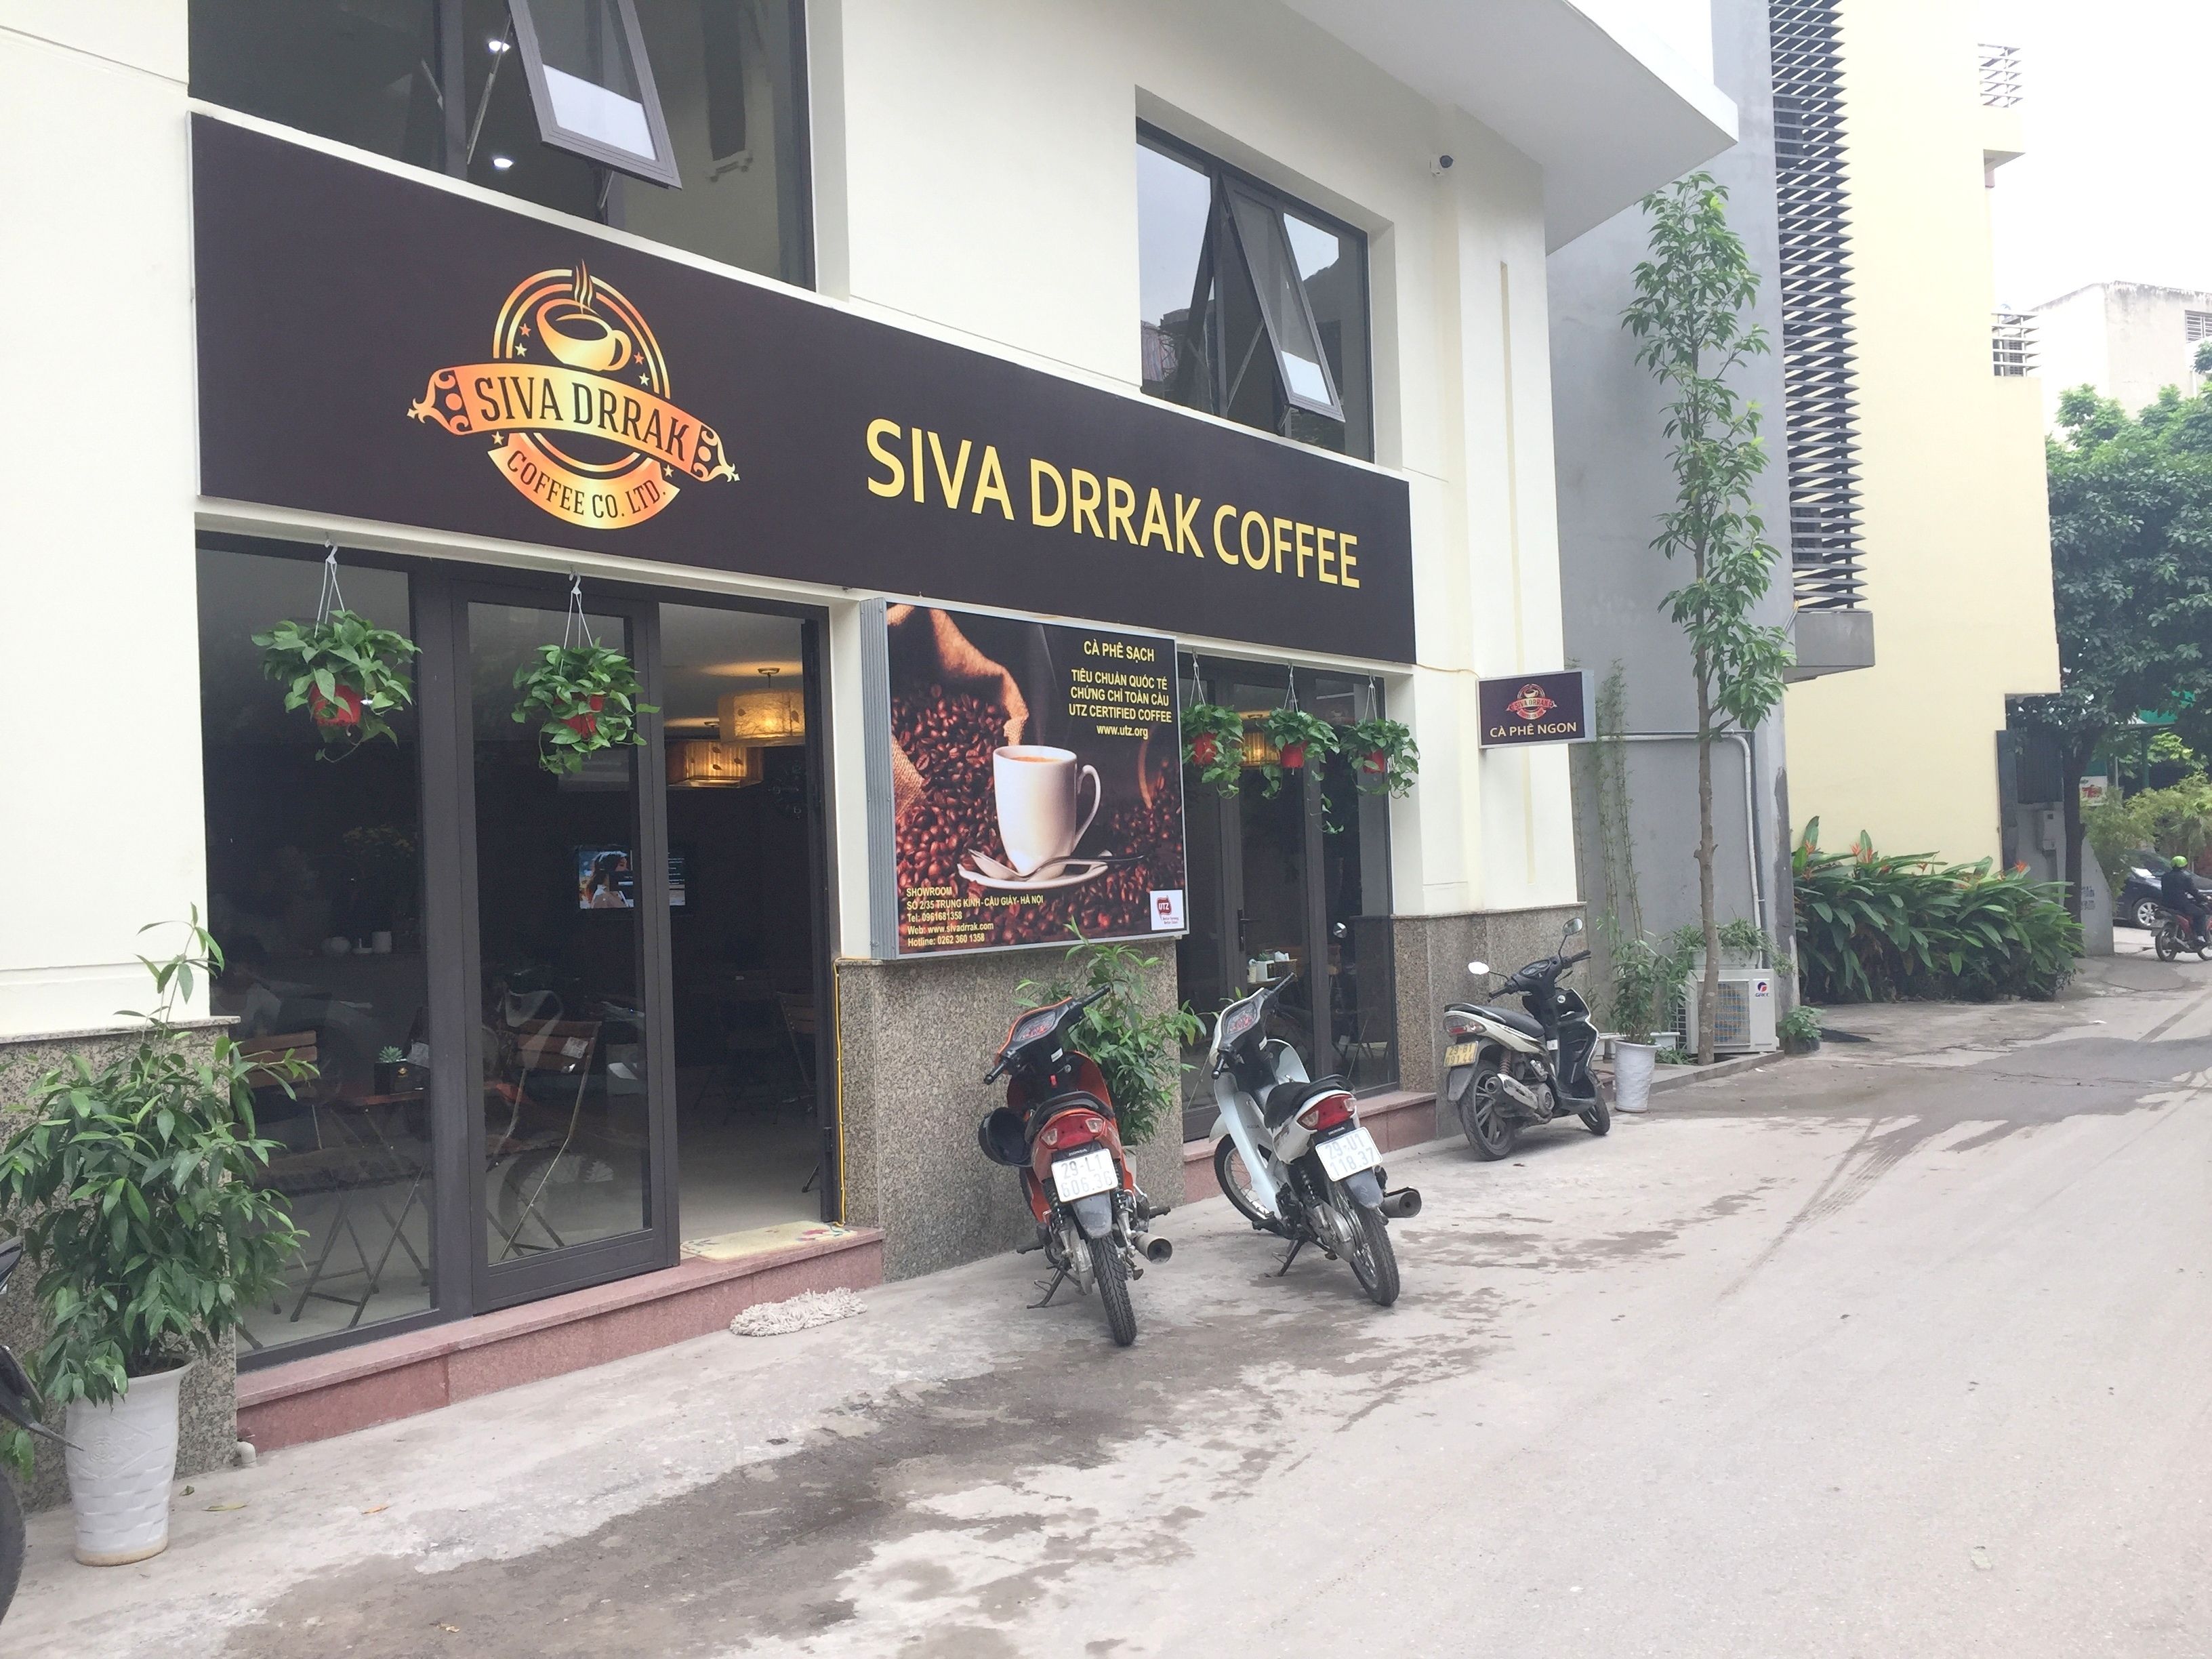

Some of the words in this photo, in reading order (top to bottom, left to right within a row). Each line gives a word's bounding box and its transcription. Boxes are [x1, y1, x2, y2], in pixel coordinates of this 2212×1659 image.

[474, 376, 562, 422] SIVA
[571, 382, 690, 462] DRRAK
[506, 450, 585, 516] COFFEE
[592, 493, 625, 518] CO.
[629, 478, 666, 515] LTD.
[866, 418, 1015, 520] SIVA
[1030, 459, 1204, 558] DRRAK
[1214, 505, 1360, 588] COFFEE
[1084, 638, 1100, 656] CÀ
[1102, 642, 1124, 659] PHÊ
[1126, 645, 1155, 663] SẠCH
[1071, 668, 1092, 683] TIÊU
[1069, 703, 1088, 716] UTZ
[1089, 705, 1136, 720] CERTIFIED
[1138, 709, 1172, 723] COFFEE
[1096, 724, 1149, 740] www.utz.org
[1490, 726, 1507, 738] CÀ
[1509, 723, 1534, 737] PHÊ
[1538, 722, 1577, 735] NGON
[906, 886, 952, 897] SHOWROOM
[920, 900, 935, 909] 2/35
[935, 899, 962, 909] TRUNG
[1158, 902, 1169, 910] UTZ
[907, 913, 920, 922] Tel:
[922, 911, 962, 922] 0961681358
[907, 925, 926, 935] Web:
[928, 922, 994, 934] www.sivadrrak.com
[907, 937, 935, 947] Hotline:
[937, 935, 954, 945] 0262
[955, 934, 968, 943] 360
[968, 933, 985, 943] 1358
[1061, 1154, 1103, 1179] 29-L1
[1061, 1171, 1113, 1197] 606.36
